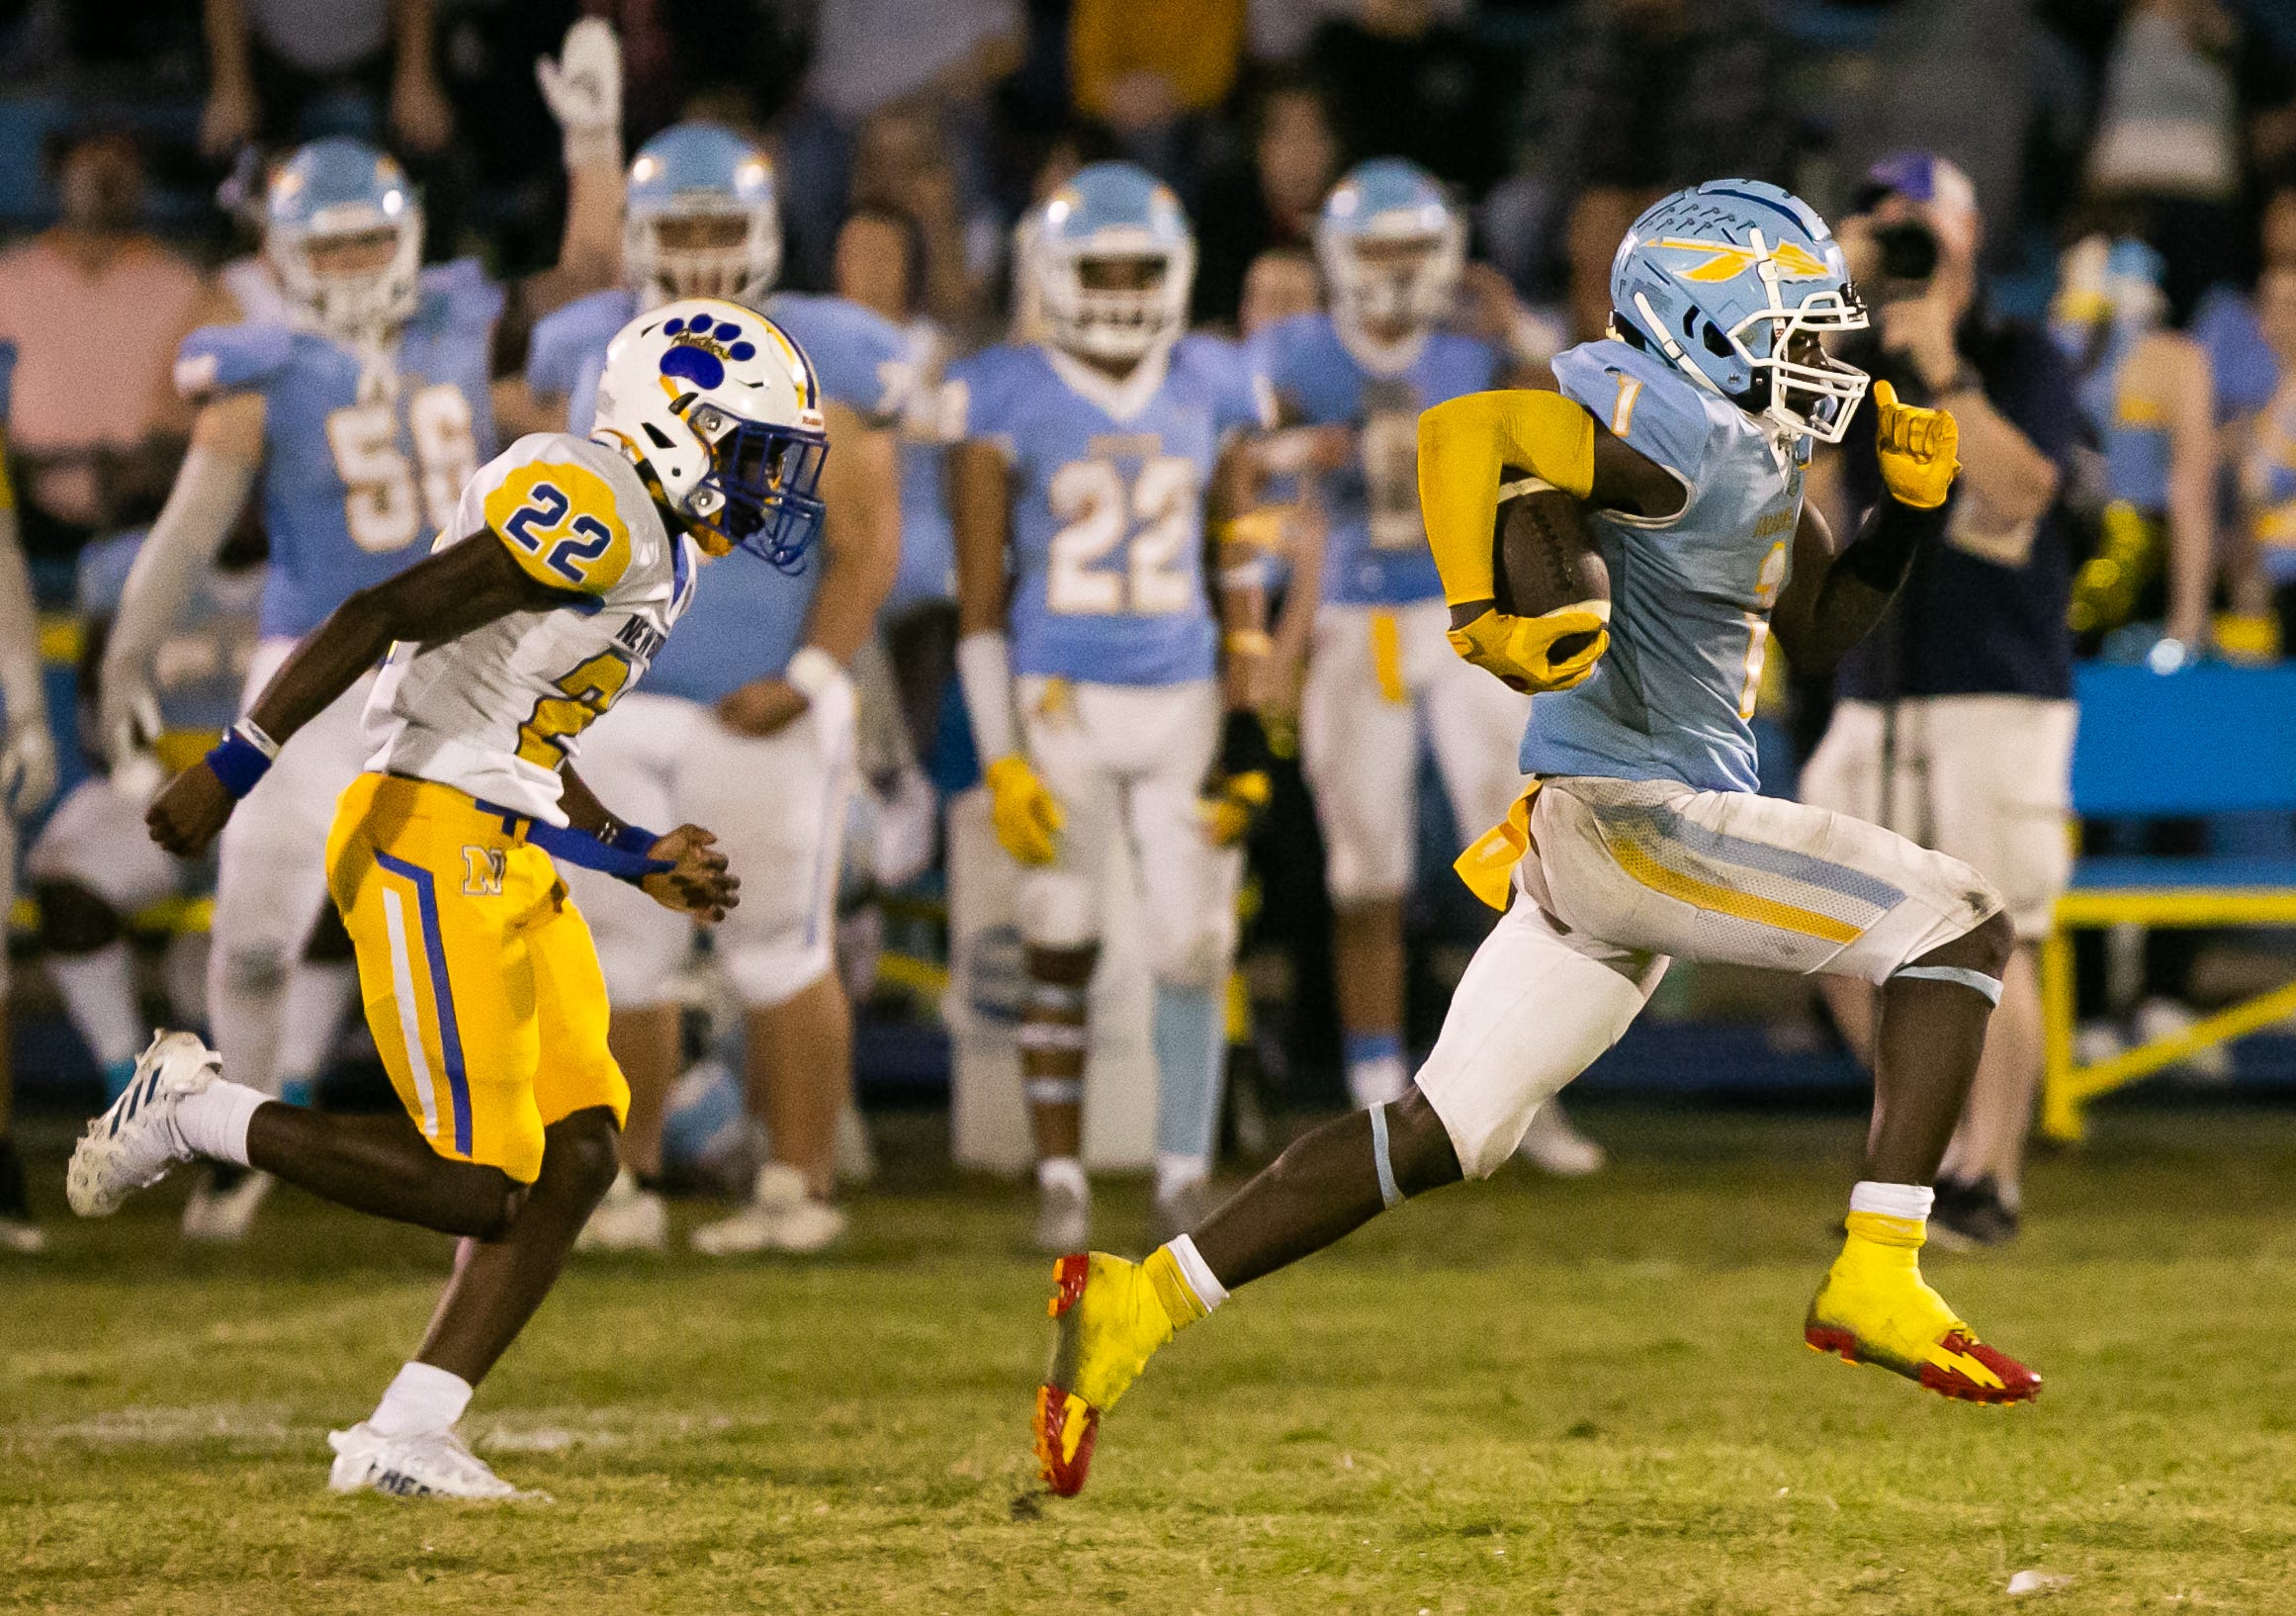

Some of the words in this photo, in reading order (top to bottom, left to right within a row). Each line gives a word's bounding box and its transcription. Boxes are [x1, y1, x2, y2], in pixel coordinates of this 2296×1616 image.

[502, 480, 613, 585] 22
[1045, 458, 1193, 615] 22
[462, 845, 505, 896] N
